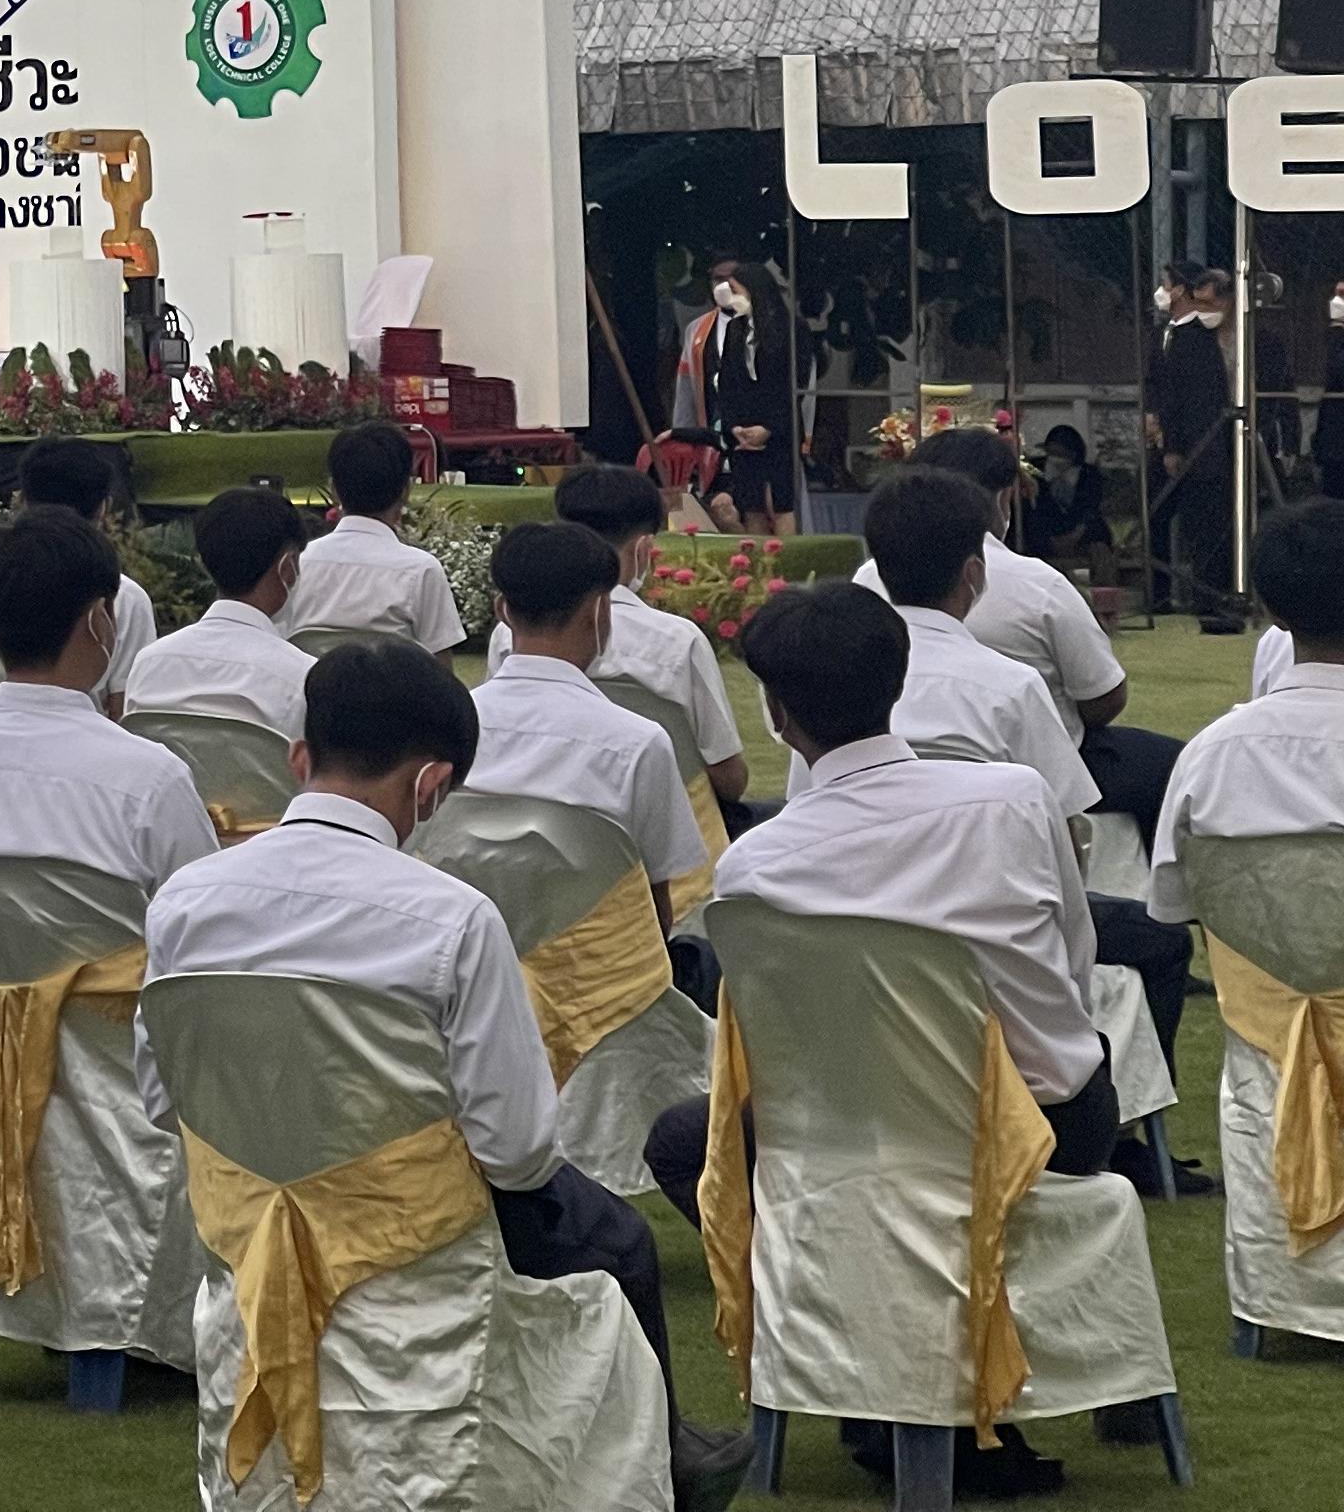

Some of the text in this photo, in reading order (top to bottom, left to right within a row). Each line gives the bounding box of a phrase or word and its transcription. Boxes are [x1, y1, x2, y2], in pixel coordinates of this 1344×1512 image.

[236, 1, 252, 41] 1
[277, 3, 291, 25] ONE
[204, 34, 292, 82] LOEI TECHNICAL COLLEGE
